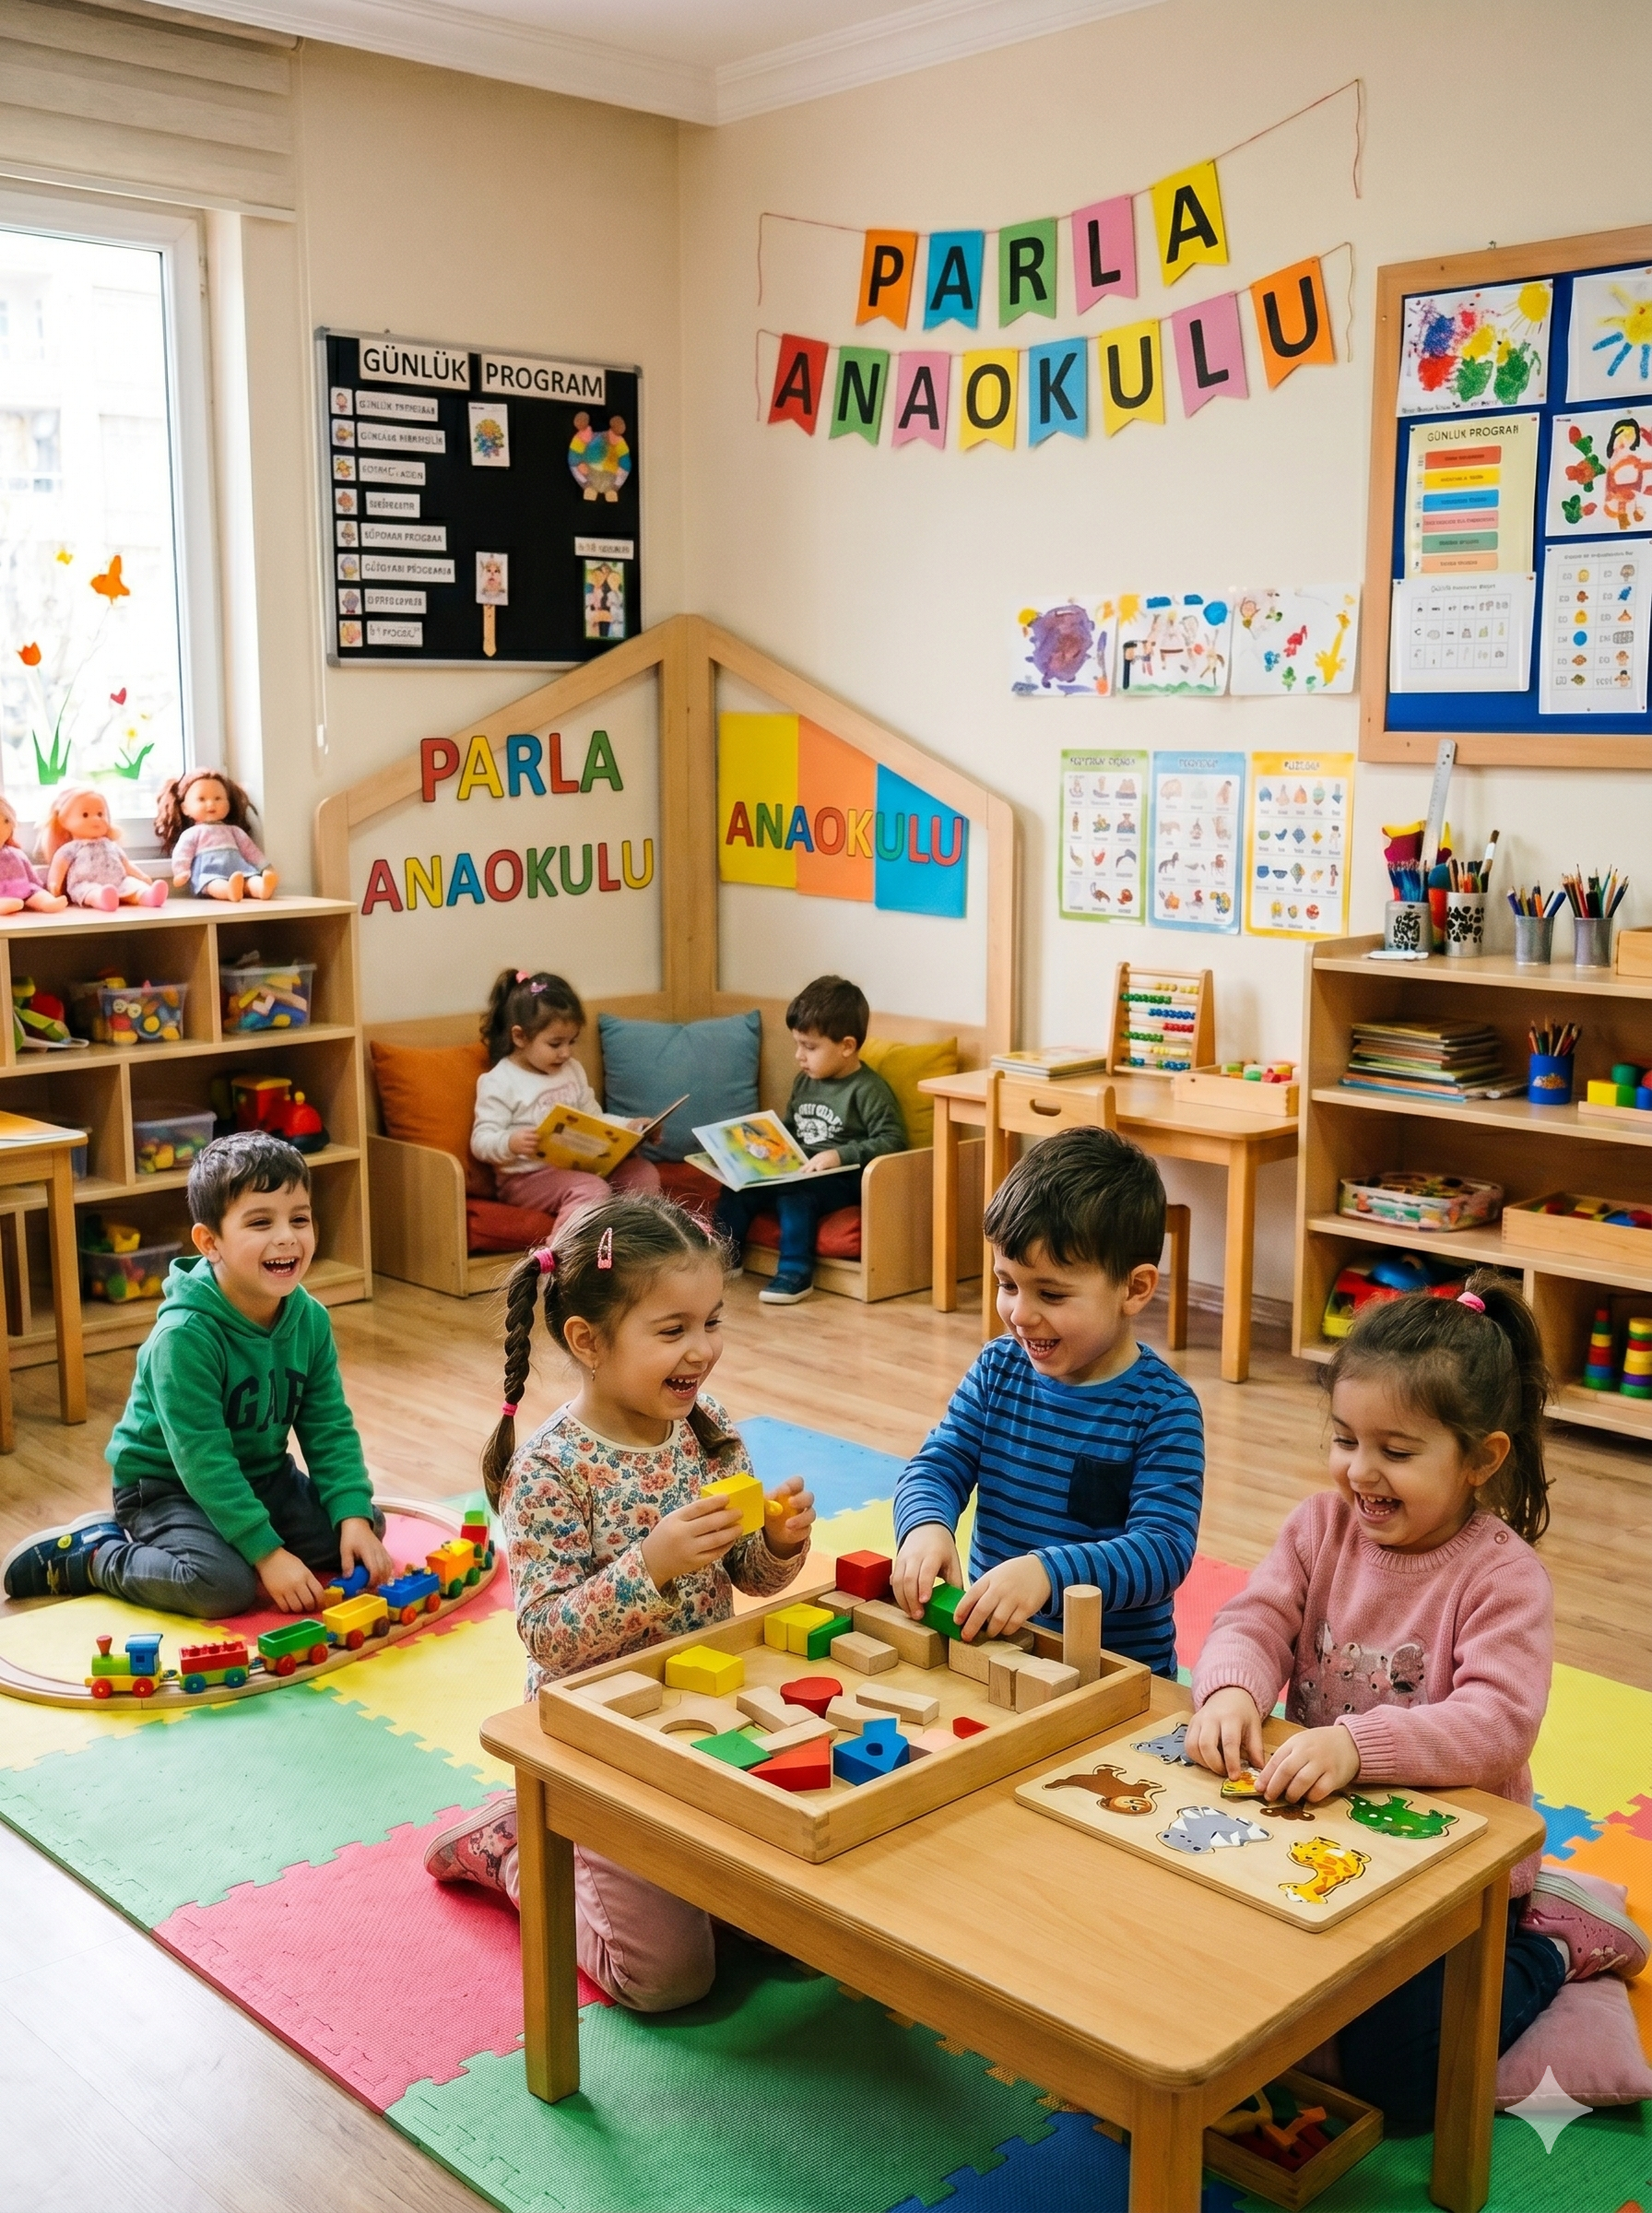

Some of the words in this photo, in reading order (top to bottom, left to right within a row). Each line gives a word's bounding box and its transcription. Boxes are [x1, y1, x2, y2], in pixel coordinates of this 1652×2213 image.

[867, 184, 1219, 311] PARLA
[363, 344, 466, 383] GÜNLÜK
[486, 361, 603, 398] PROGRAM
[773, 275, 1320, 431] ANAOKULU
[420, 729, 624, 802] PARLA
[725, 800, 964, 867] ANAOKULU
[360, 837, 654, 915] ANAOKULU
